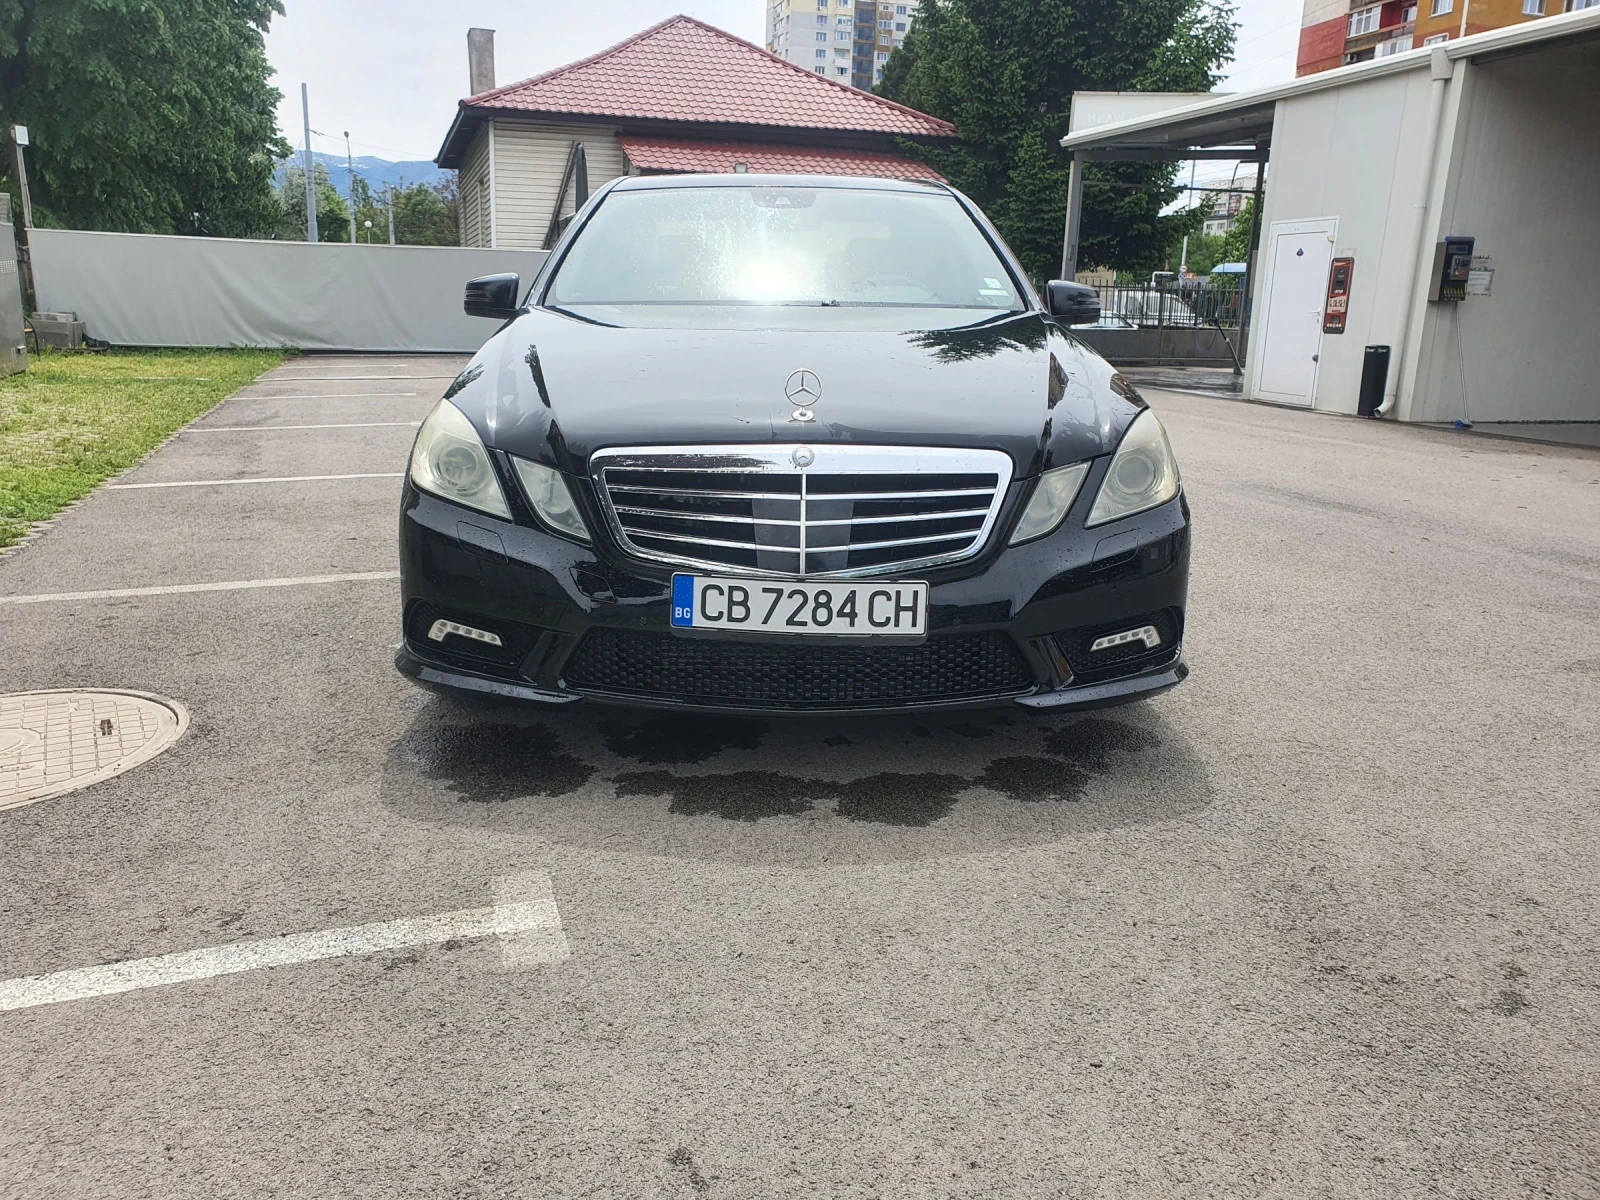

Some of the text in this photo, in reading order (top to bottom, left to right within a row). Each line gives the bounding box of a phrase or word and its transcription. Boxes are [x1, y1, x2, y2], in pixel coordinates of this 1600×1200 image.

[674, 607, 691, 619] BG
[700, 583, 919, 628] CB 7284 CH
